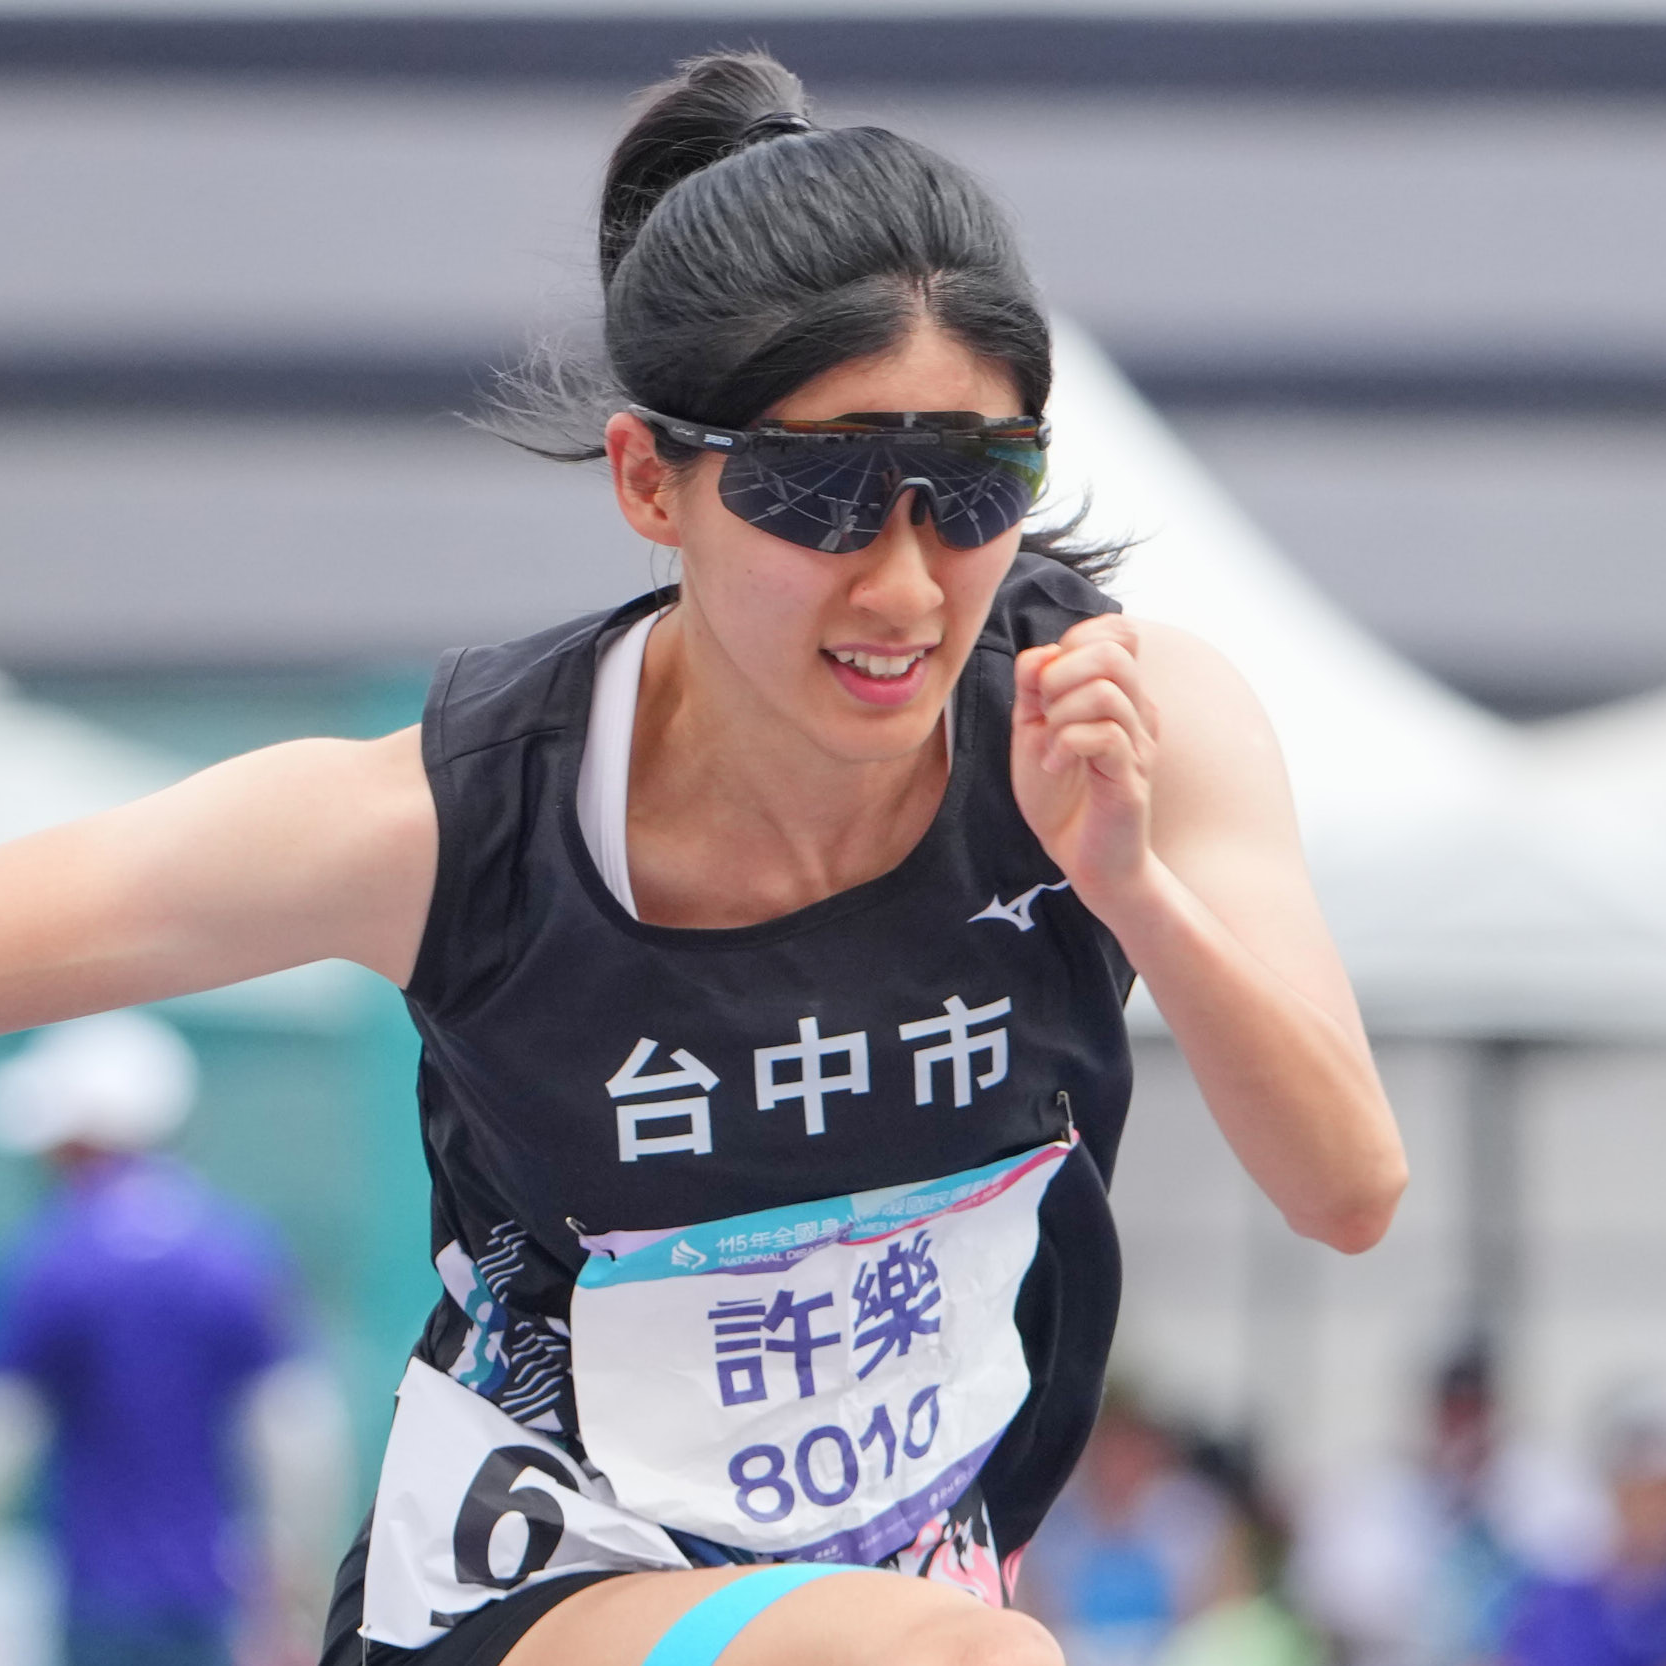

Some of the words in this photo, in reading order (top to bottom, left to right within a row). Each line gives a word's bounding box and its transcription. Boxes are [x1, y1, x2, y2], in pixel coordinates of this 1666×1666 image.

[604, 994, 1012, 1163] 台中市
[708, 1230, 941, 1406] 許樂
[453, 1445, 579, 1590] 6
[728, 1384, 940, 1523] 8010
